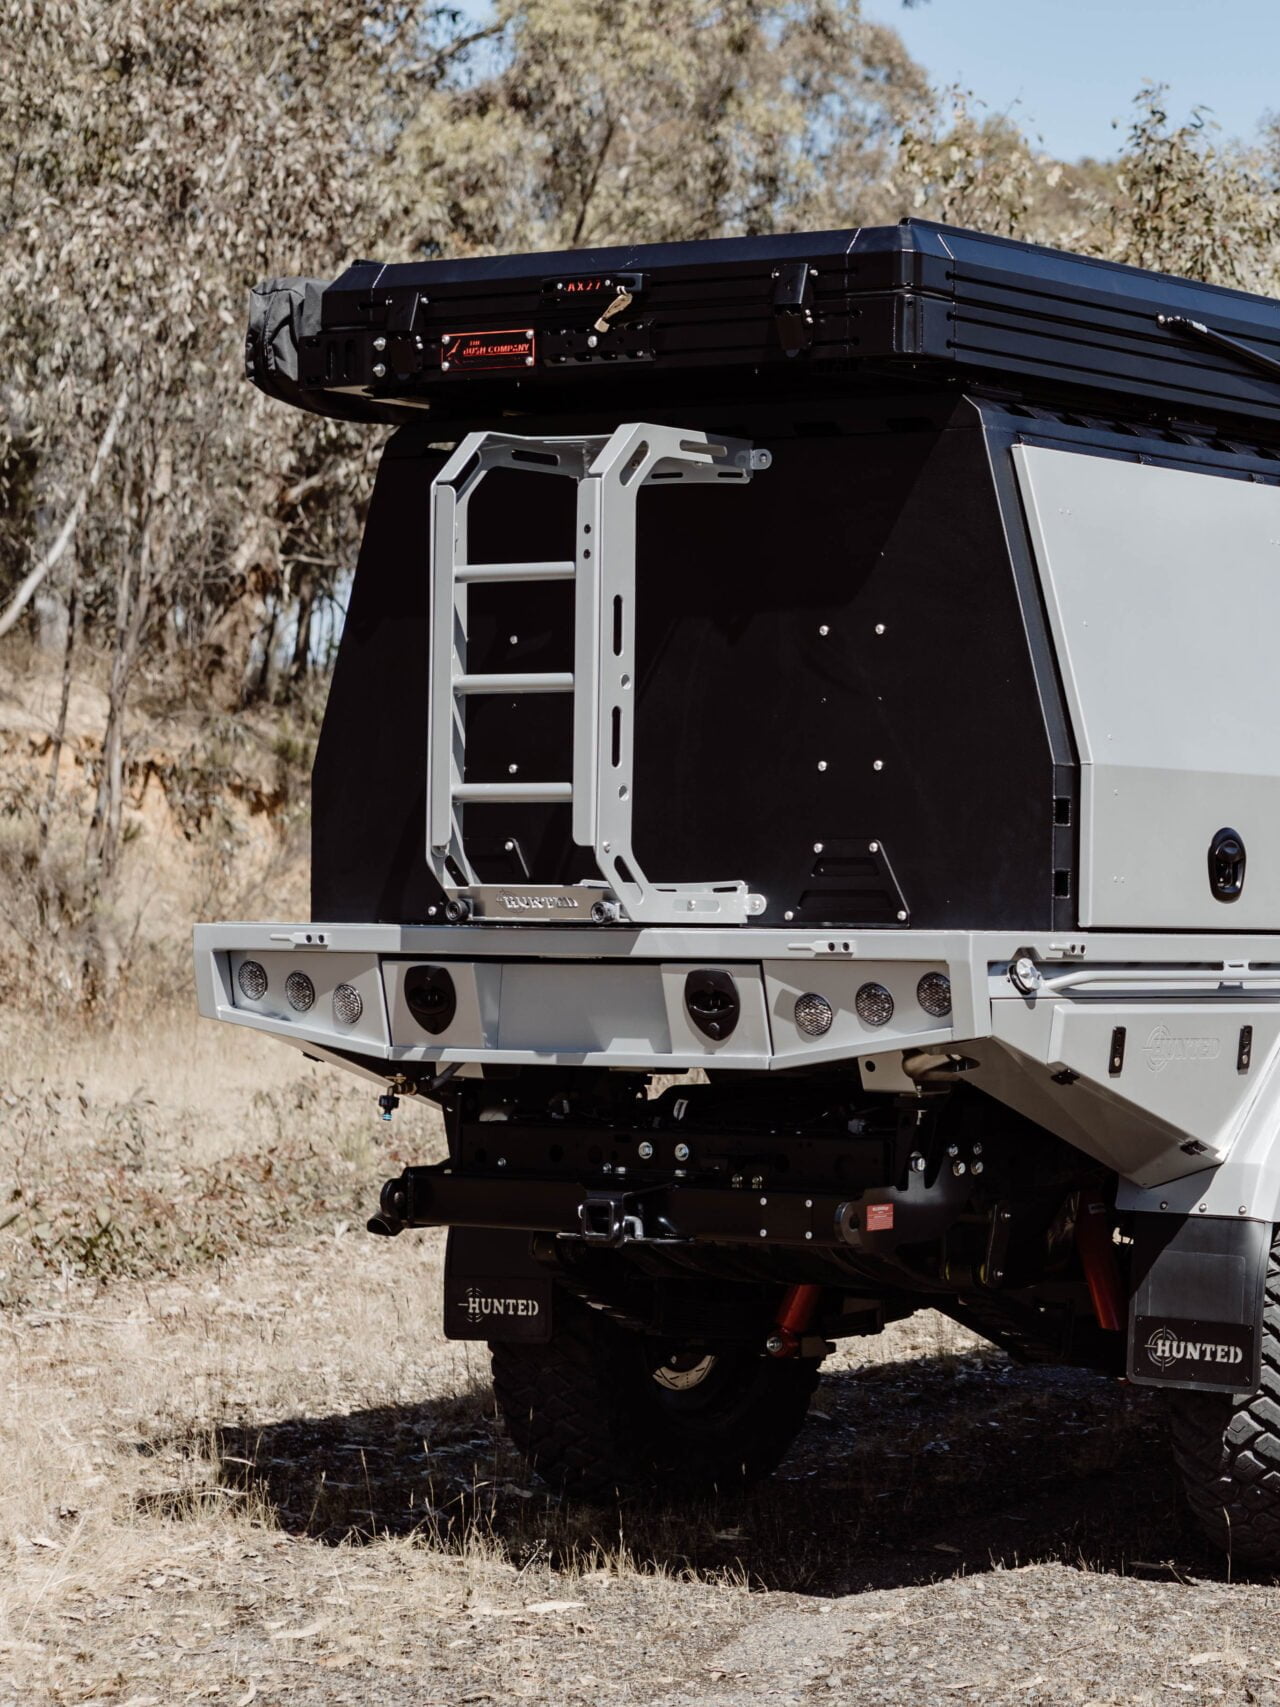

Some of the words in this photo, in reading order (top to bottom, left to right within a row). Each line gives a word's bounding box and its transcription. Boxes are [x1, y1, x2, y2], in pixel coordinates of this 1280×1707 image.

[567, 280, 601, 292] AX27
[503, 895, 579, 909] HUNTED
[468, 1297, 539, 1316] HUNTED
[1156, 1339, 1243, 1364] HUNTED
